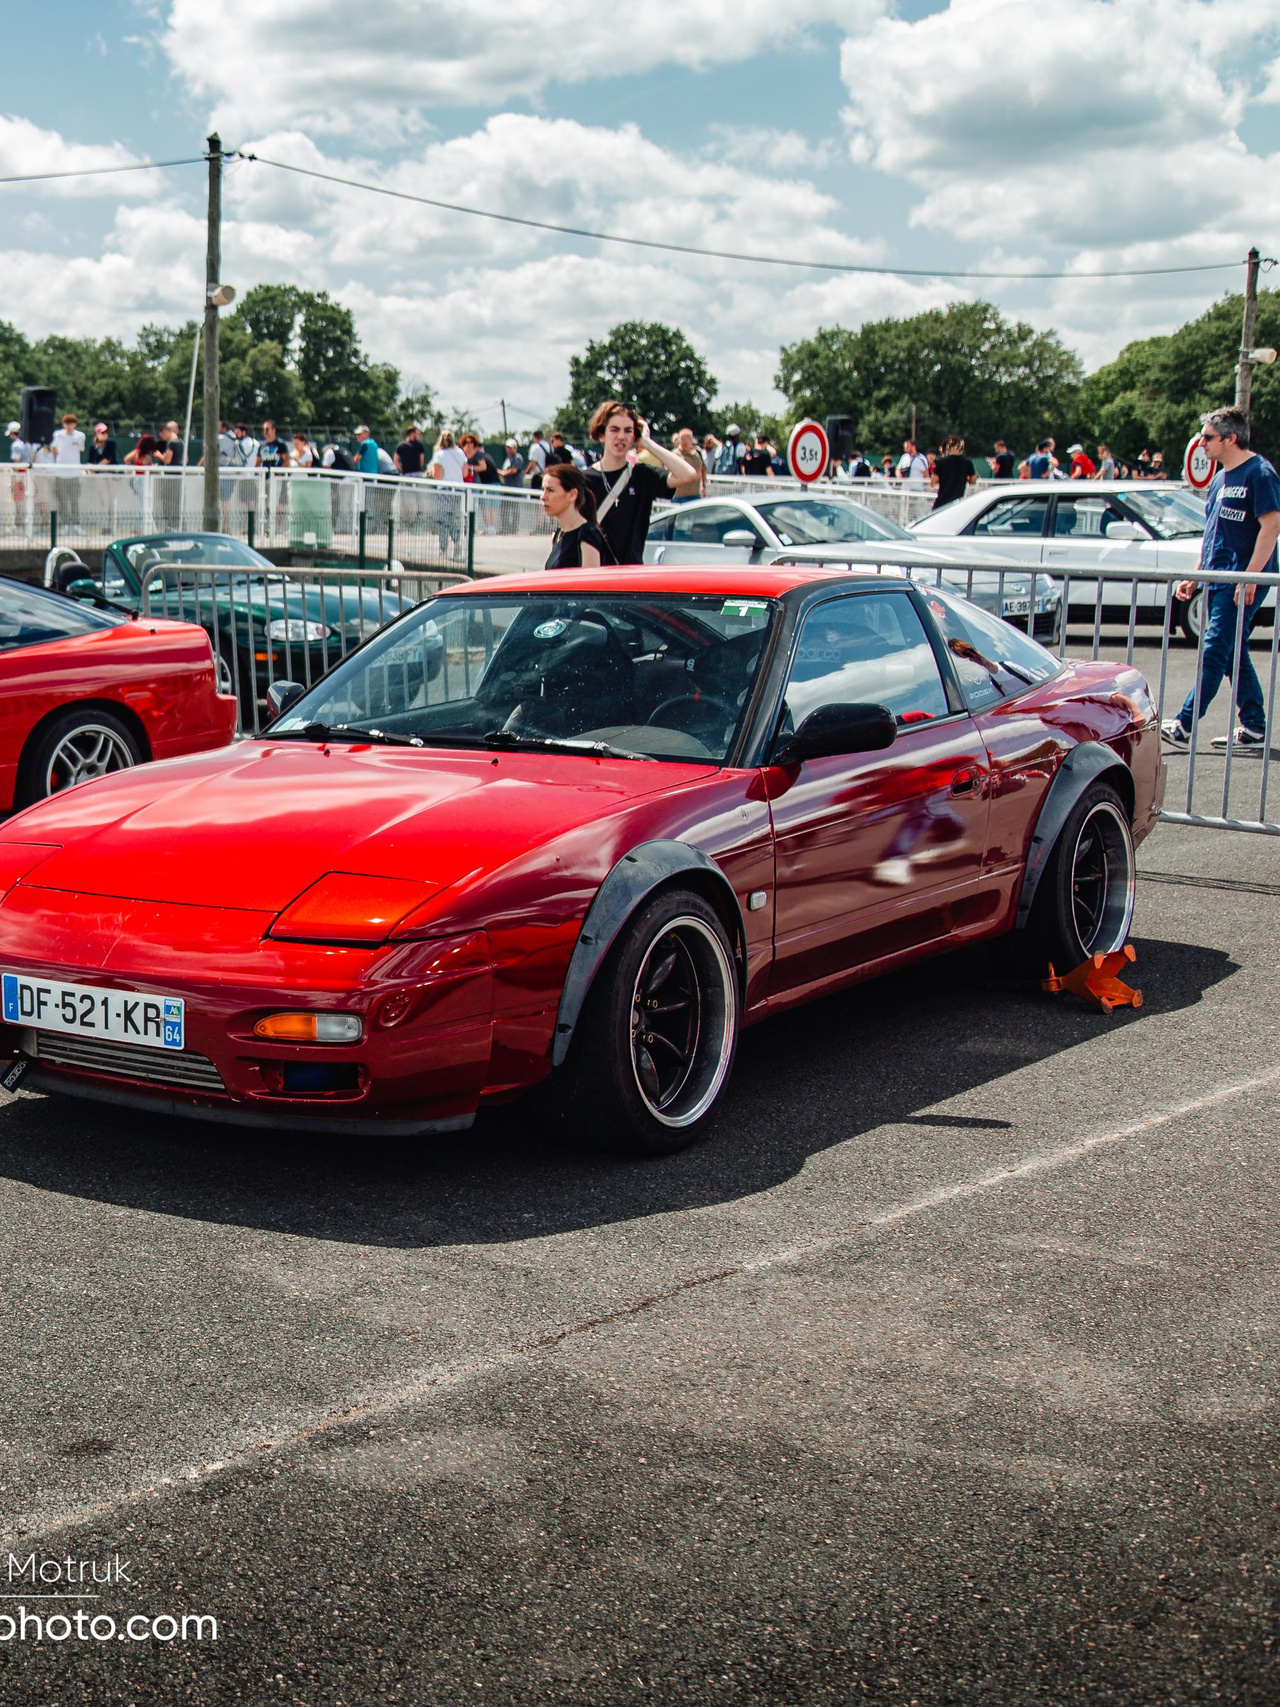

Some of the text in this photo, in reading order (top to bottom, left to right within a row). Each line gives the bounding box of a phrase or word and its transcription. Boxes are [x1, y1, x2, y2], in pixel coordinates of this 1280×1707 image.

[801, 446, 818, 463] 3,5t
[1194, 457, 1208, 471] 3,5t
[1221, 507, 1244, 521] MARVEL
[738, 606, 750, 618] 1
[798, 647, 841, 660] parco
[969, 687, 993, 700] 200SX
[9, 1003, 15, 1012] F
[20, 983, 160, 1037] DF-521-KR
[165, 1025, 181, 1043] 64
